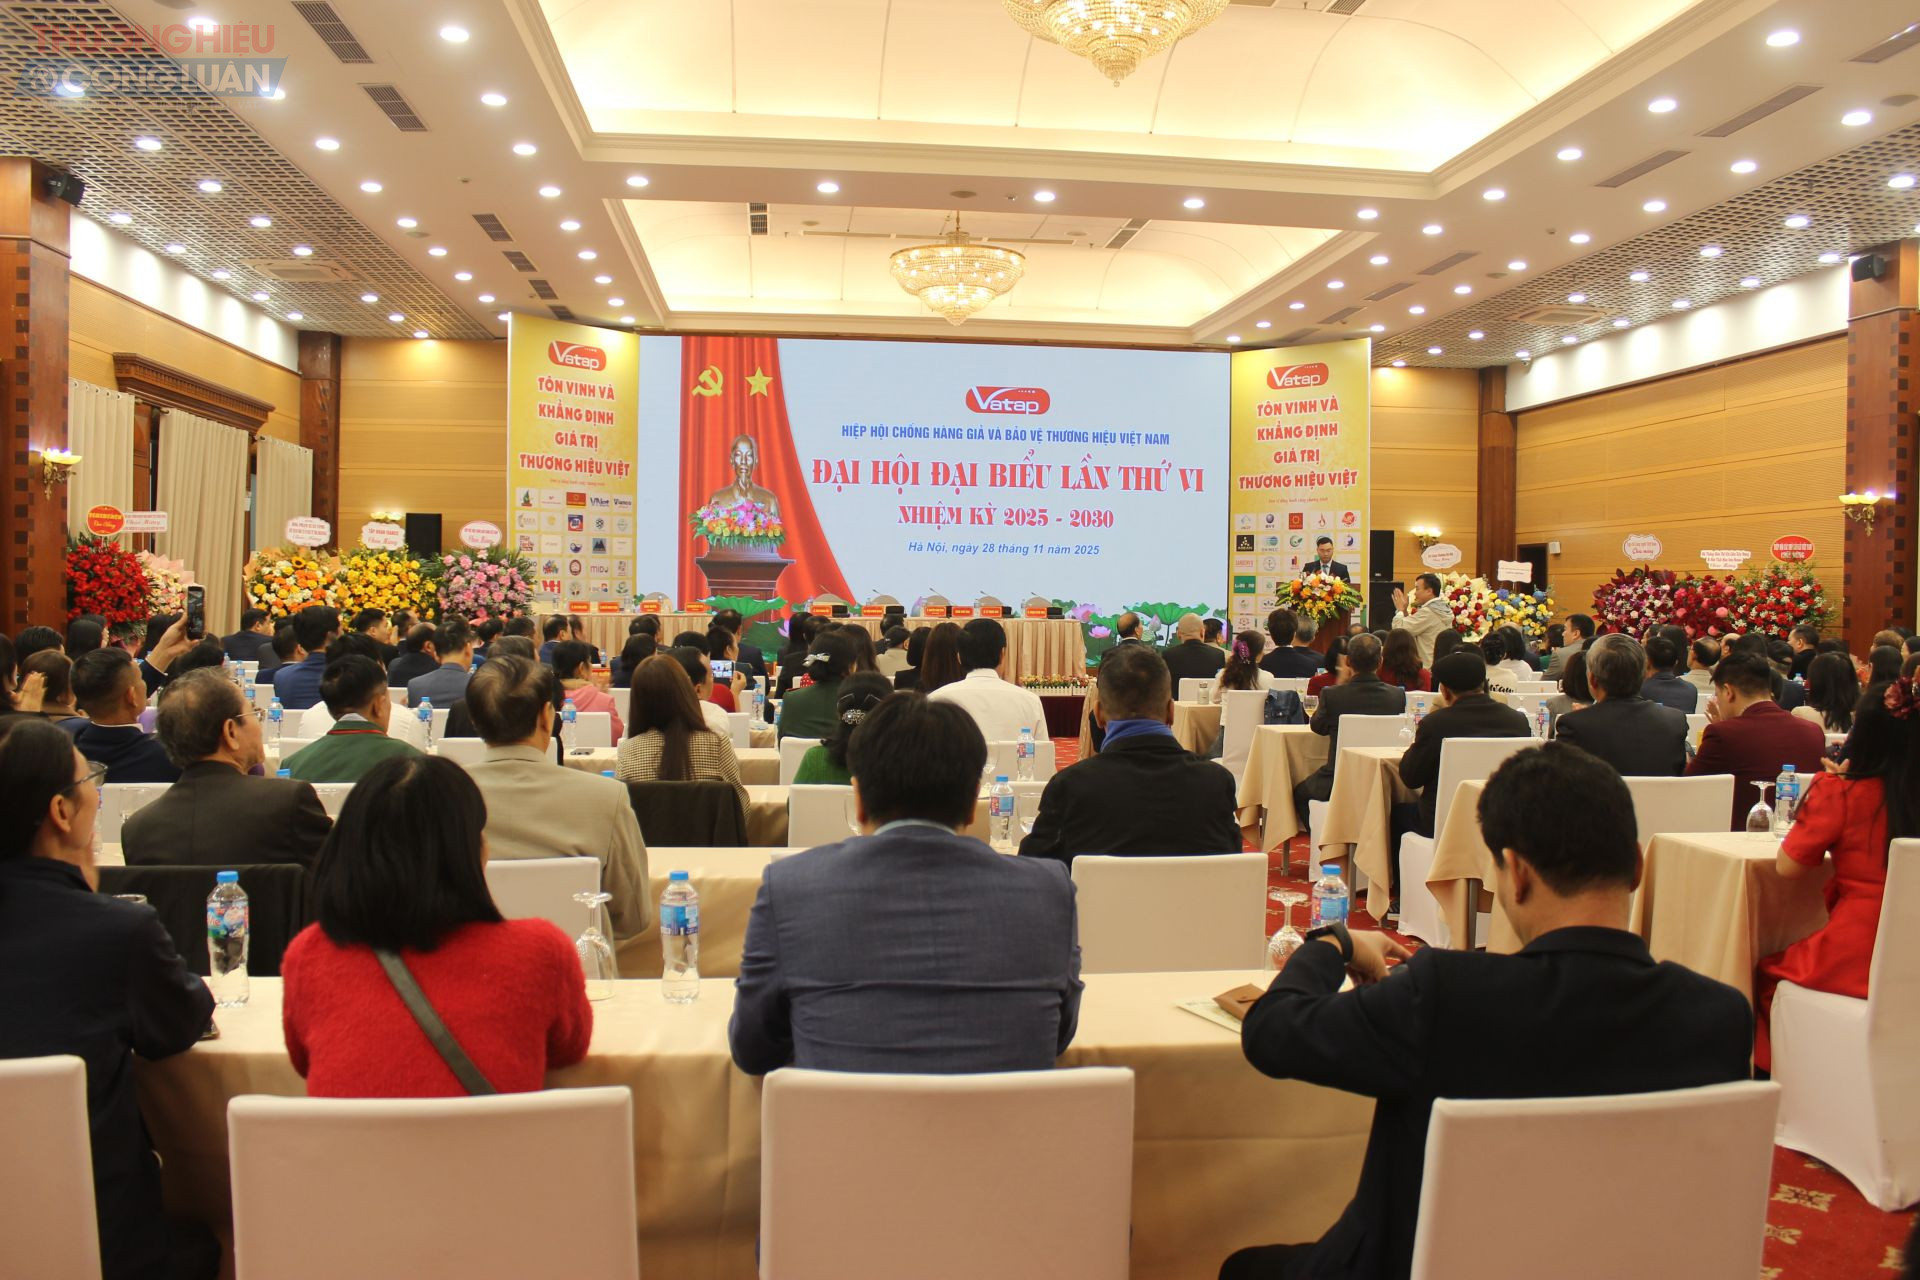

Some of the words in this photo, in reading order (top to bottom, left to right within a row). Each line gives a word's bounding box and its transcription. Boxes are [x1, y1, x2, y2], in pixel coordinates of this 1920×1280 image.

[552, 340, 600, 370] Vatap
[538, 375, 563, 392] TÔN
[566, 381, 596, 398] VINH
[599, 384, 614, 400] VÀ
[1270, 364, 1320, 387] Vatap
[971, 385, 1040, 415] Vatap
[1257, 401, 1282, 416] TÔN
[1286, 400, 1316, 414] VINH
[1320, 395, 1338, 412] VÀ
[538, 399, 582, 422] KHẲNG
[585, 410, 614, 427] ĐỊNH
[555, 430, 577, 447] GIÁ
[580, 434, 598, 452] TRỊ
[842, 423, 866, 440] HIỆP
[870, 424, 888, 440] HỘI
[892, 422, 930, 439] CHỐNG
[933, 425, 963, 440] HÀNG
[966, 424, 984, 440] GIẢ
[988, 426, 1000, 440] VÀ
[1005, 426, 1026, 441] BẢO
[1030, 428, 1043, 444] VỆ
[1046, 429, 1088, 444] THƯƠNG
[1092, 430, 1116, 446] HIỆU
[1120, 430, 1142, 447] VIỆT
[1145, 433, 1170, 446] NAM
[1257, 420, 1302, 440] KHẲNG
[520, 454, 572, 472] THƯƠNG
[575, 458, 602, 477] HIỆU
[605, 460, 630, 479] VIỆT
[1274, 448, 1298, 464] GIÁ
[1300, 449, 1320, 464] TRỊ
[812, 458, 860, 493] ĐẠI
[871, 452, 920, 495] HỘI
[930, 461, 978, 496] ĐẠI
[988, 448, 1052, 490] BIỂU
[1060, 452, 1111, 490] LẦN
[1118, 458, 1172, 492] THỨ
[1178, 468, 1205, 492] VI
[1239, 474, 1292, 490] THƯƠNG
[1294, 471, 1325, 490] HIỆU
[1328, 469, 1358, 488] VIỆT
[897, 500, 962, 530] NHIỆM
[969, 502, 998, 526] KỲ
[1004, 508, 1048, 526] 2025
[1070, 509, 1114, 528] 2030
[908, 541, 923, 552] Hà
[926, 542, 948, 554] Nội,
[952, 543, 978, 555] ngày
[982, 543, 995, 553] 28
[998, 544, 1029, 556] tháng
[1033, 544, 1044, 554] 11
[1047, 545, 1071, 554] năm
[1074, 545, 1100, 555] 2025
